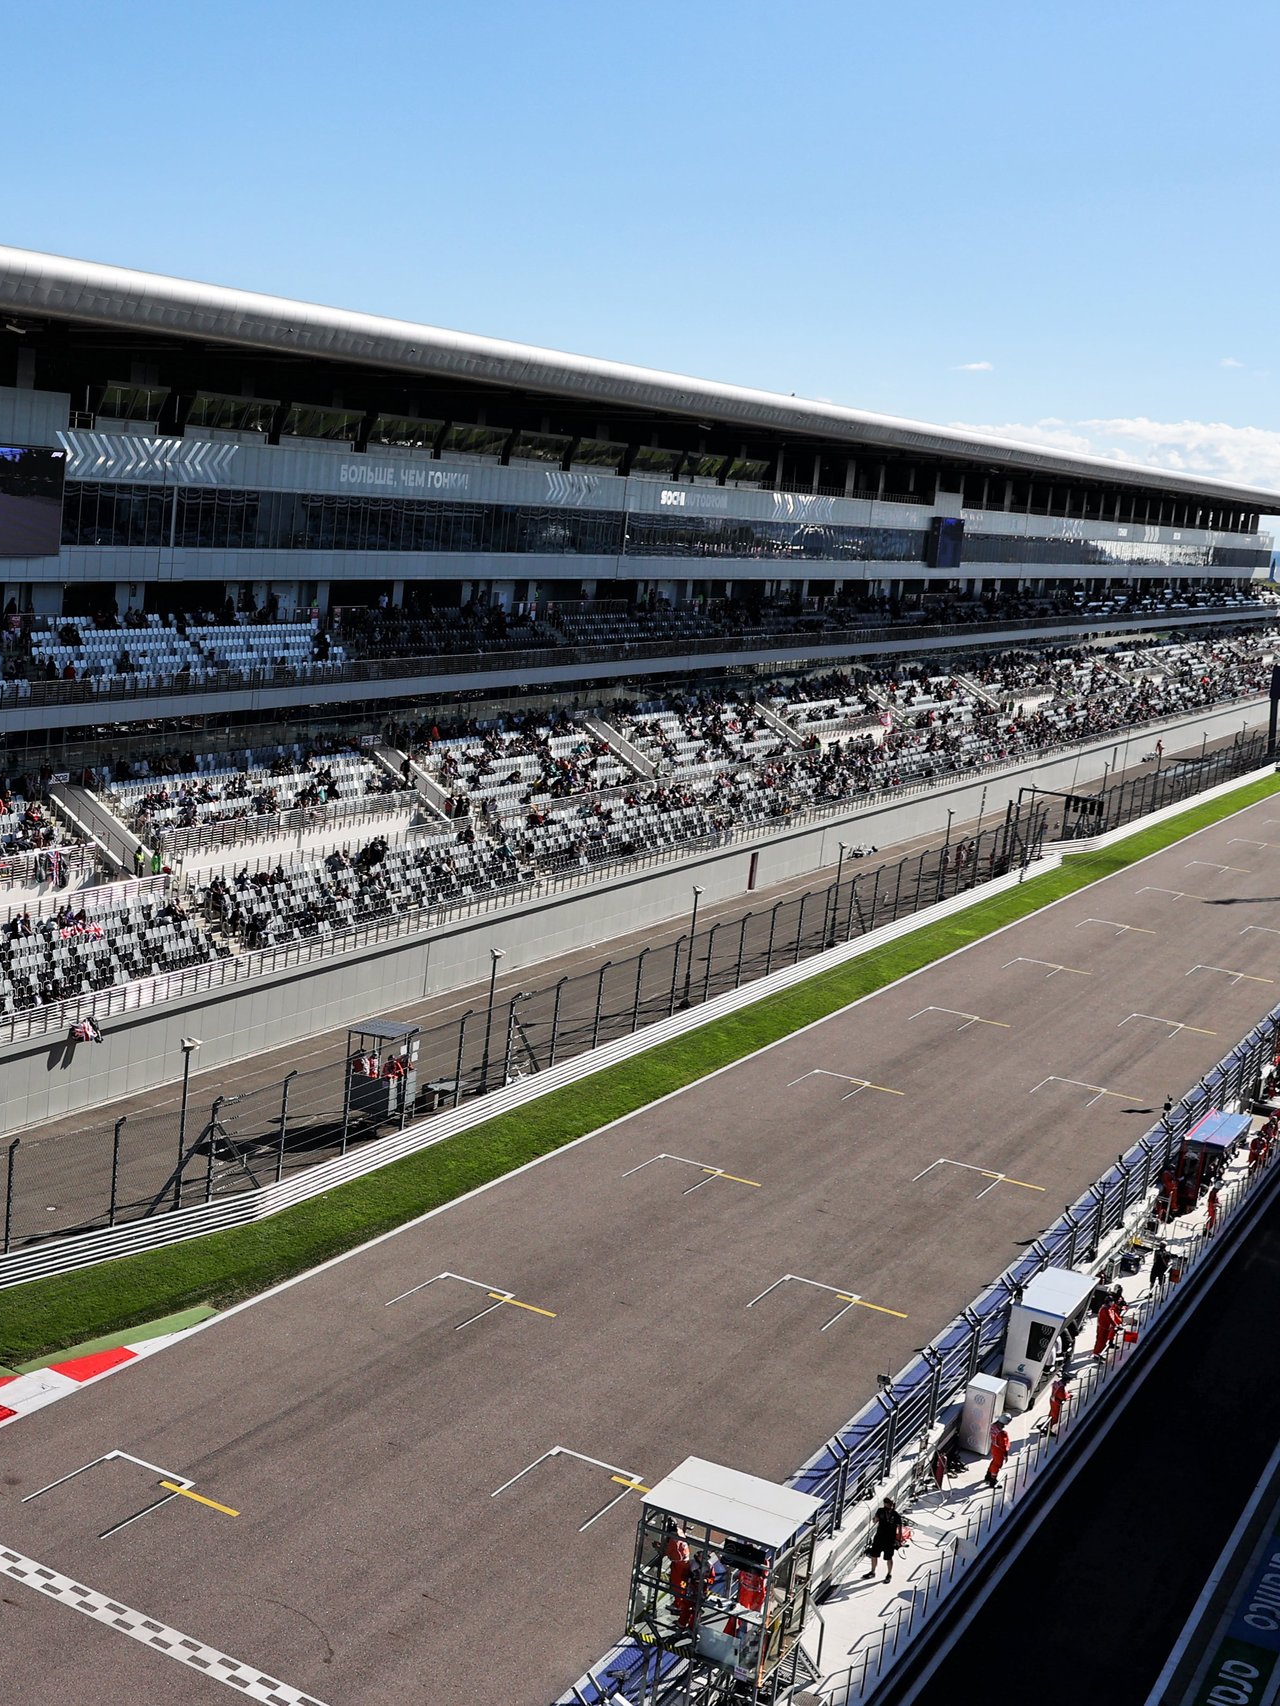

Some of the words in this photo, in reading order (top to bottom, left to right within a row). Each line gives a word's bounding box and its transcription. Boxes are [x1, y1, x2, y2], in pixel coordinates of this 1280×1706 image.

[339, 464, 397, 488] БОЛЬШЕ,
[400, 469, 426, 487] ЧЕМ
[427, 470, 469, 490] ГОНКИ!
